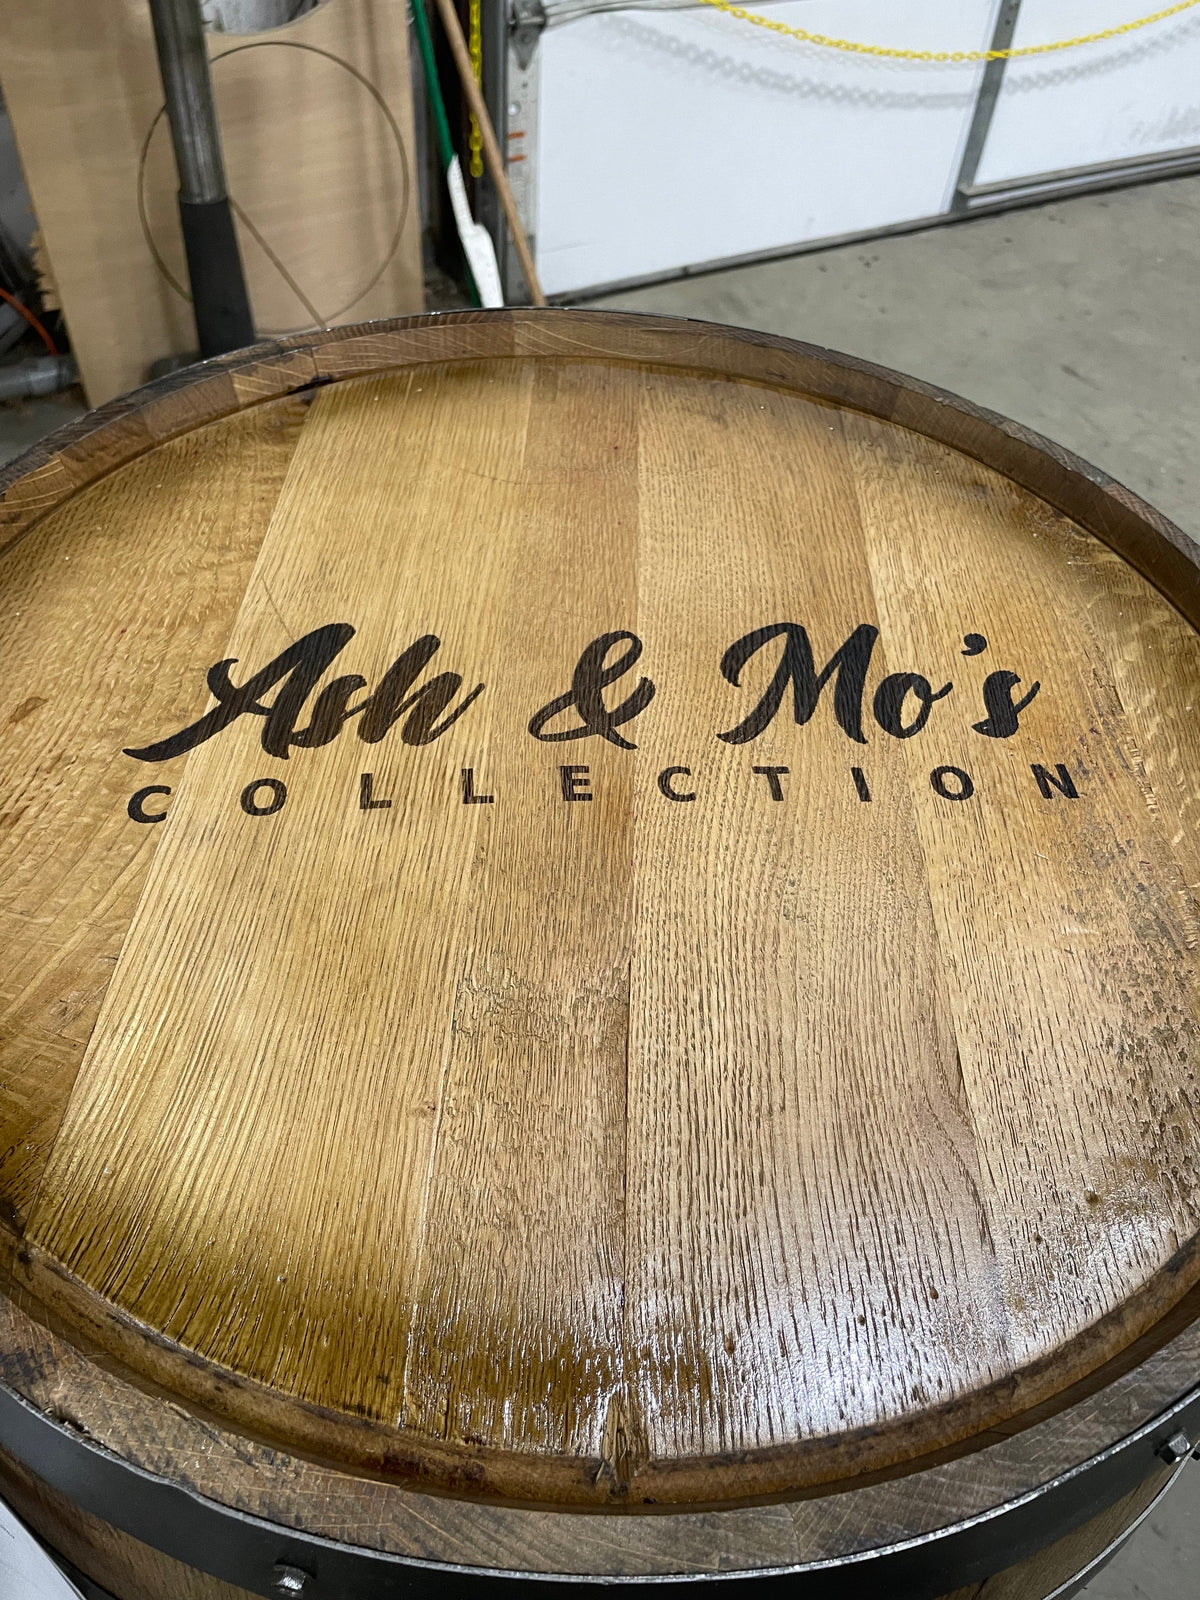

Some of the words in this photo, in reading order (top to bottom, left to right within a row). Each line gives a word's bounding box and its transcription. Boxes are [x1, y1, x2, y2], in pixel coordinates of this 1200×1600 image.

[123, 622, 485, 761] Ash
[528, 630, 654, 750] &
[717, 622, 1041, 746] Mo's
[127, 763, 1079, 824] COLLECTION
